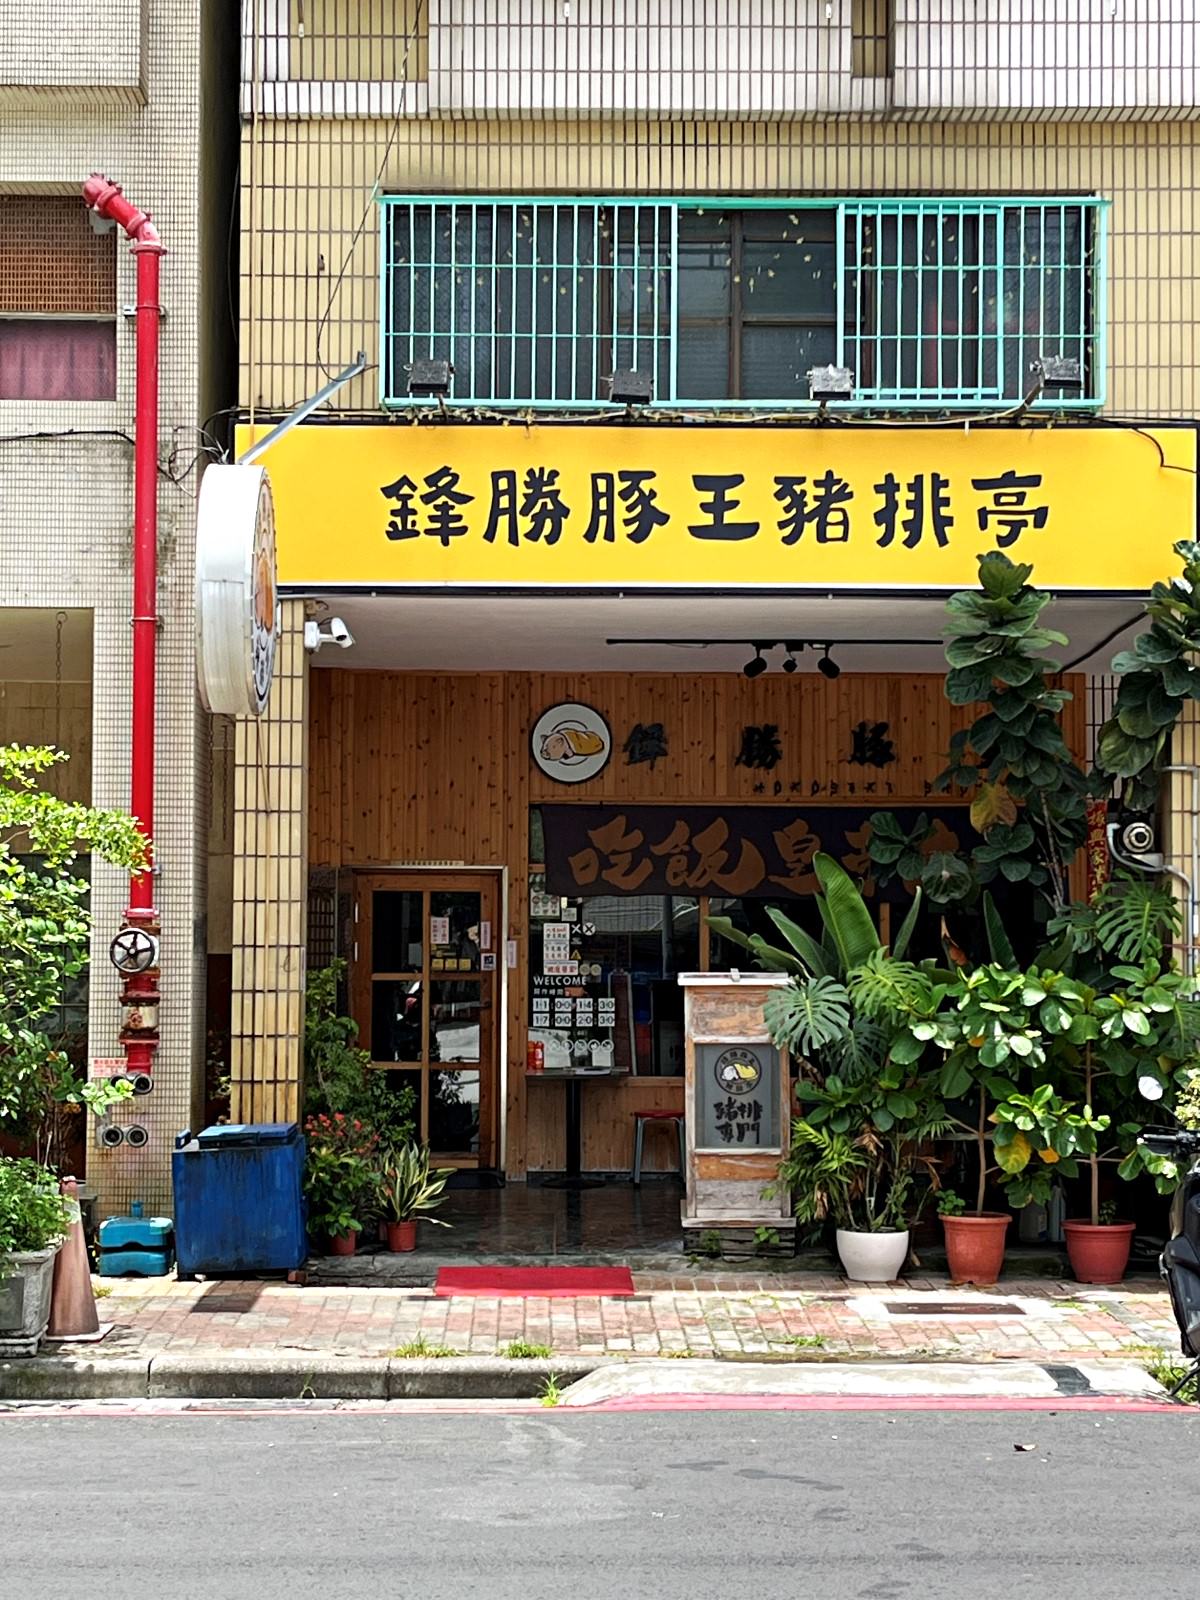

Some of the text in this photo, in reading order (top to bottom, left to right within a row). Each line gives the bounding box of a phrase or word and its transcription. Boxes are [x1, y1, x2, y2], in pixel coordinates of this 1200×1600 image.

[379, 466, 1049, 548] 鋒勝豚王豬排亭
[533, 976, 587, 986] WELCOME
[715, 1121, 761, 1145] 專門
